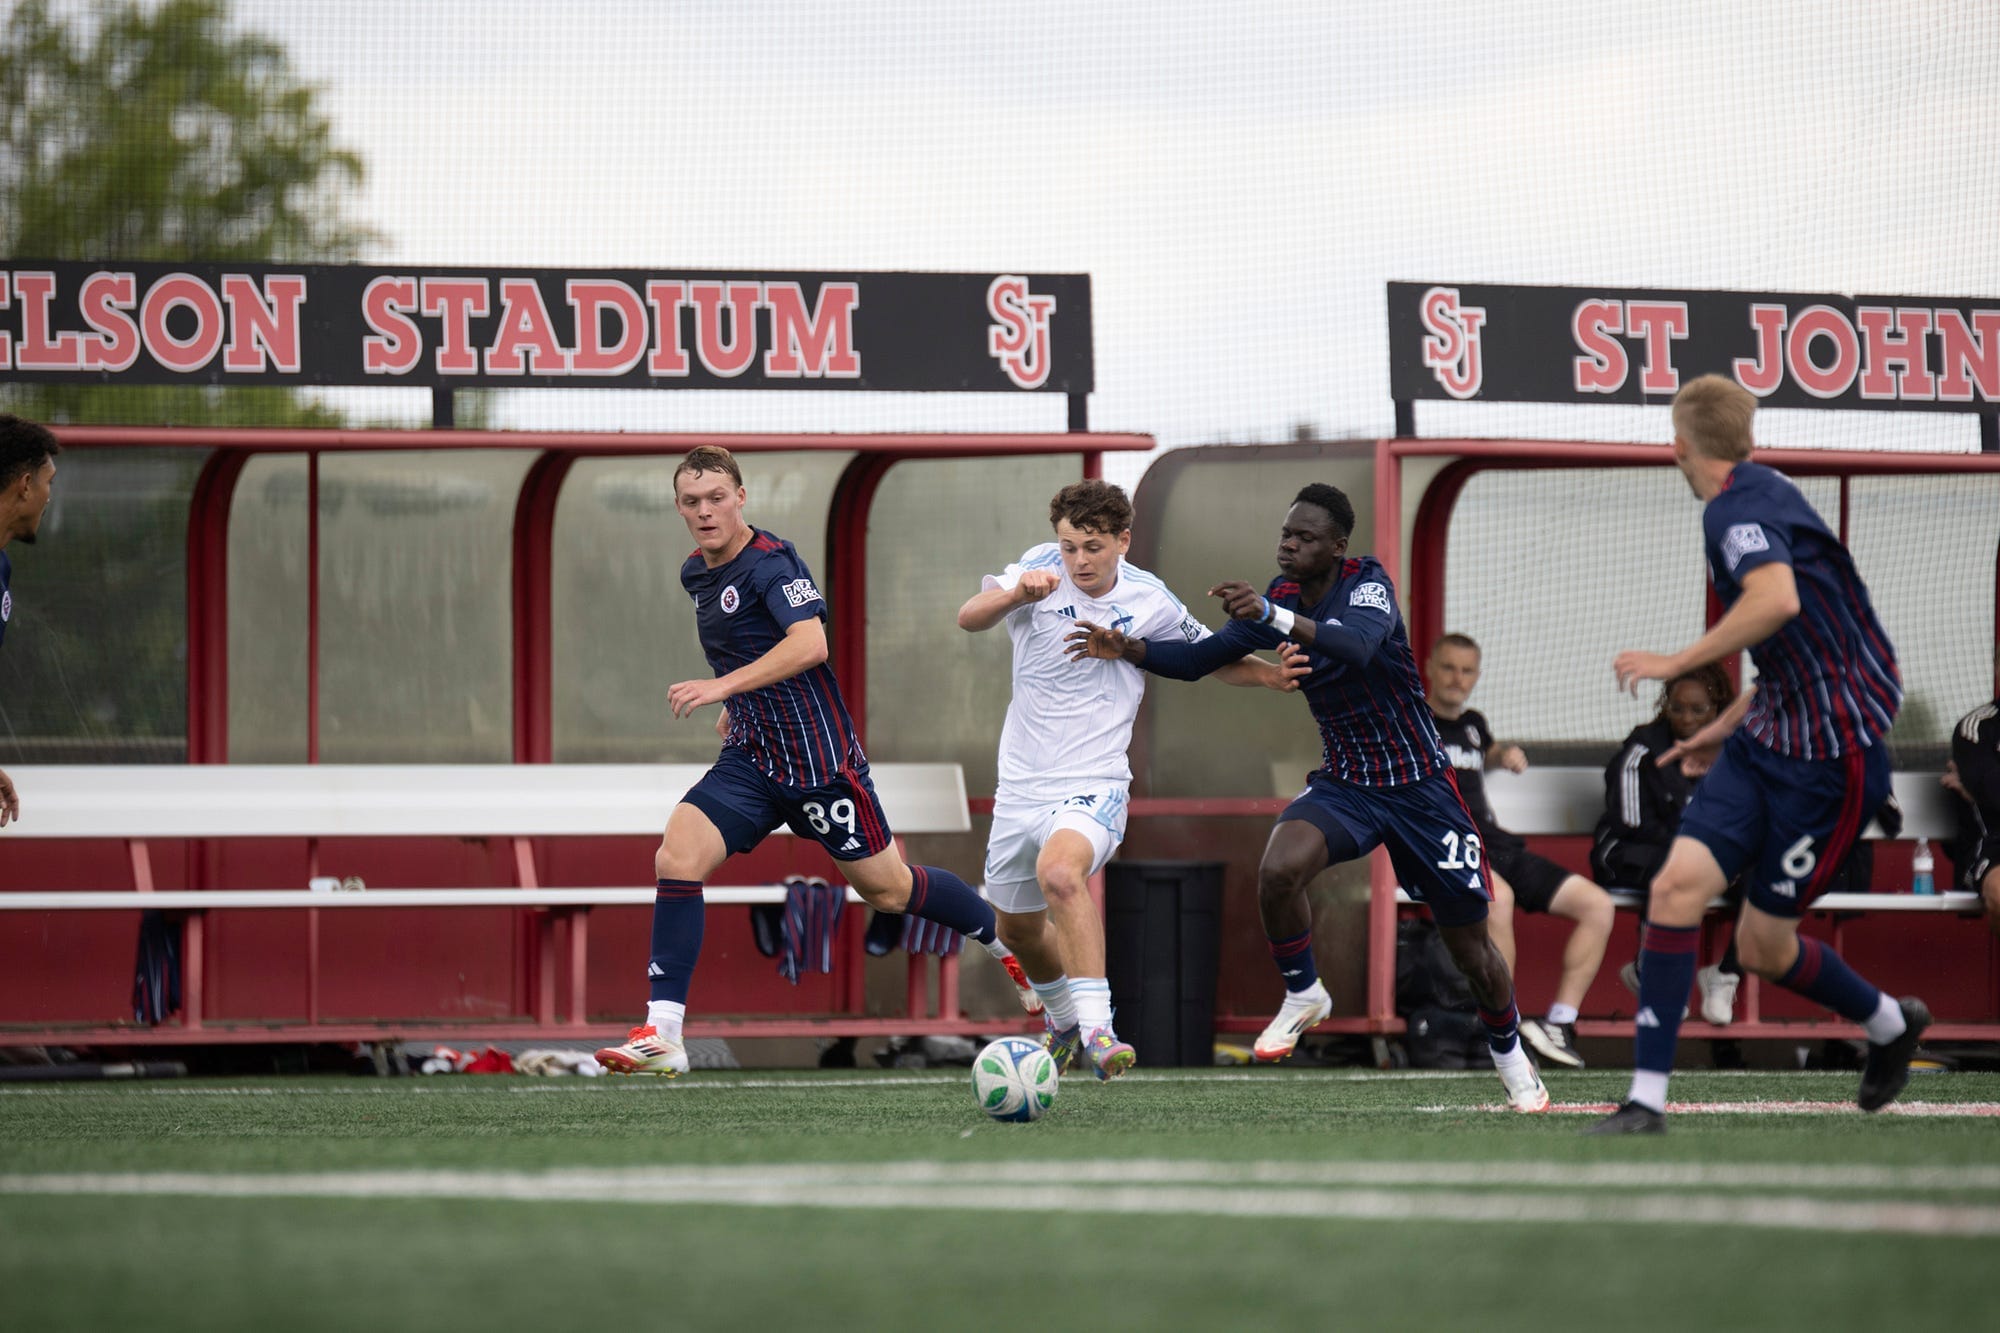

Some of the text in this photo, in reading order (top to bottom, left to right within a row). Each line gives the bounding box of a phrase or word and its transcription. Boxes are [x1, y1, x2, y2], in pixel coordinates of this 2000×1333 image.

[0, 270, 861, 378] LSON STADIUM
[1573, 298, 2000, 402] ST JOHN
[802, 798, 855, 834] 89
[1437, 830, 1481, 869] 18
[1781, 834, 1816, 879] 6
